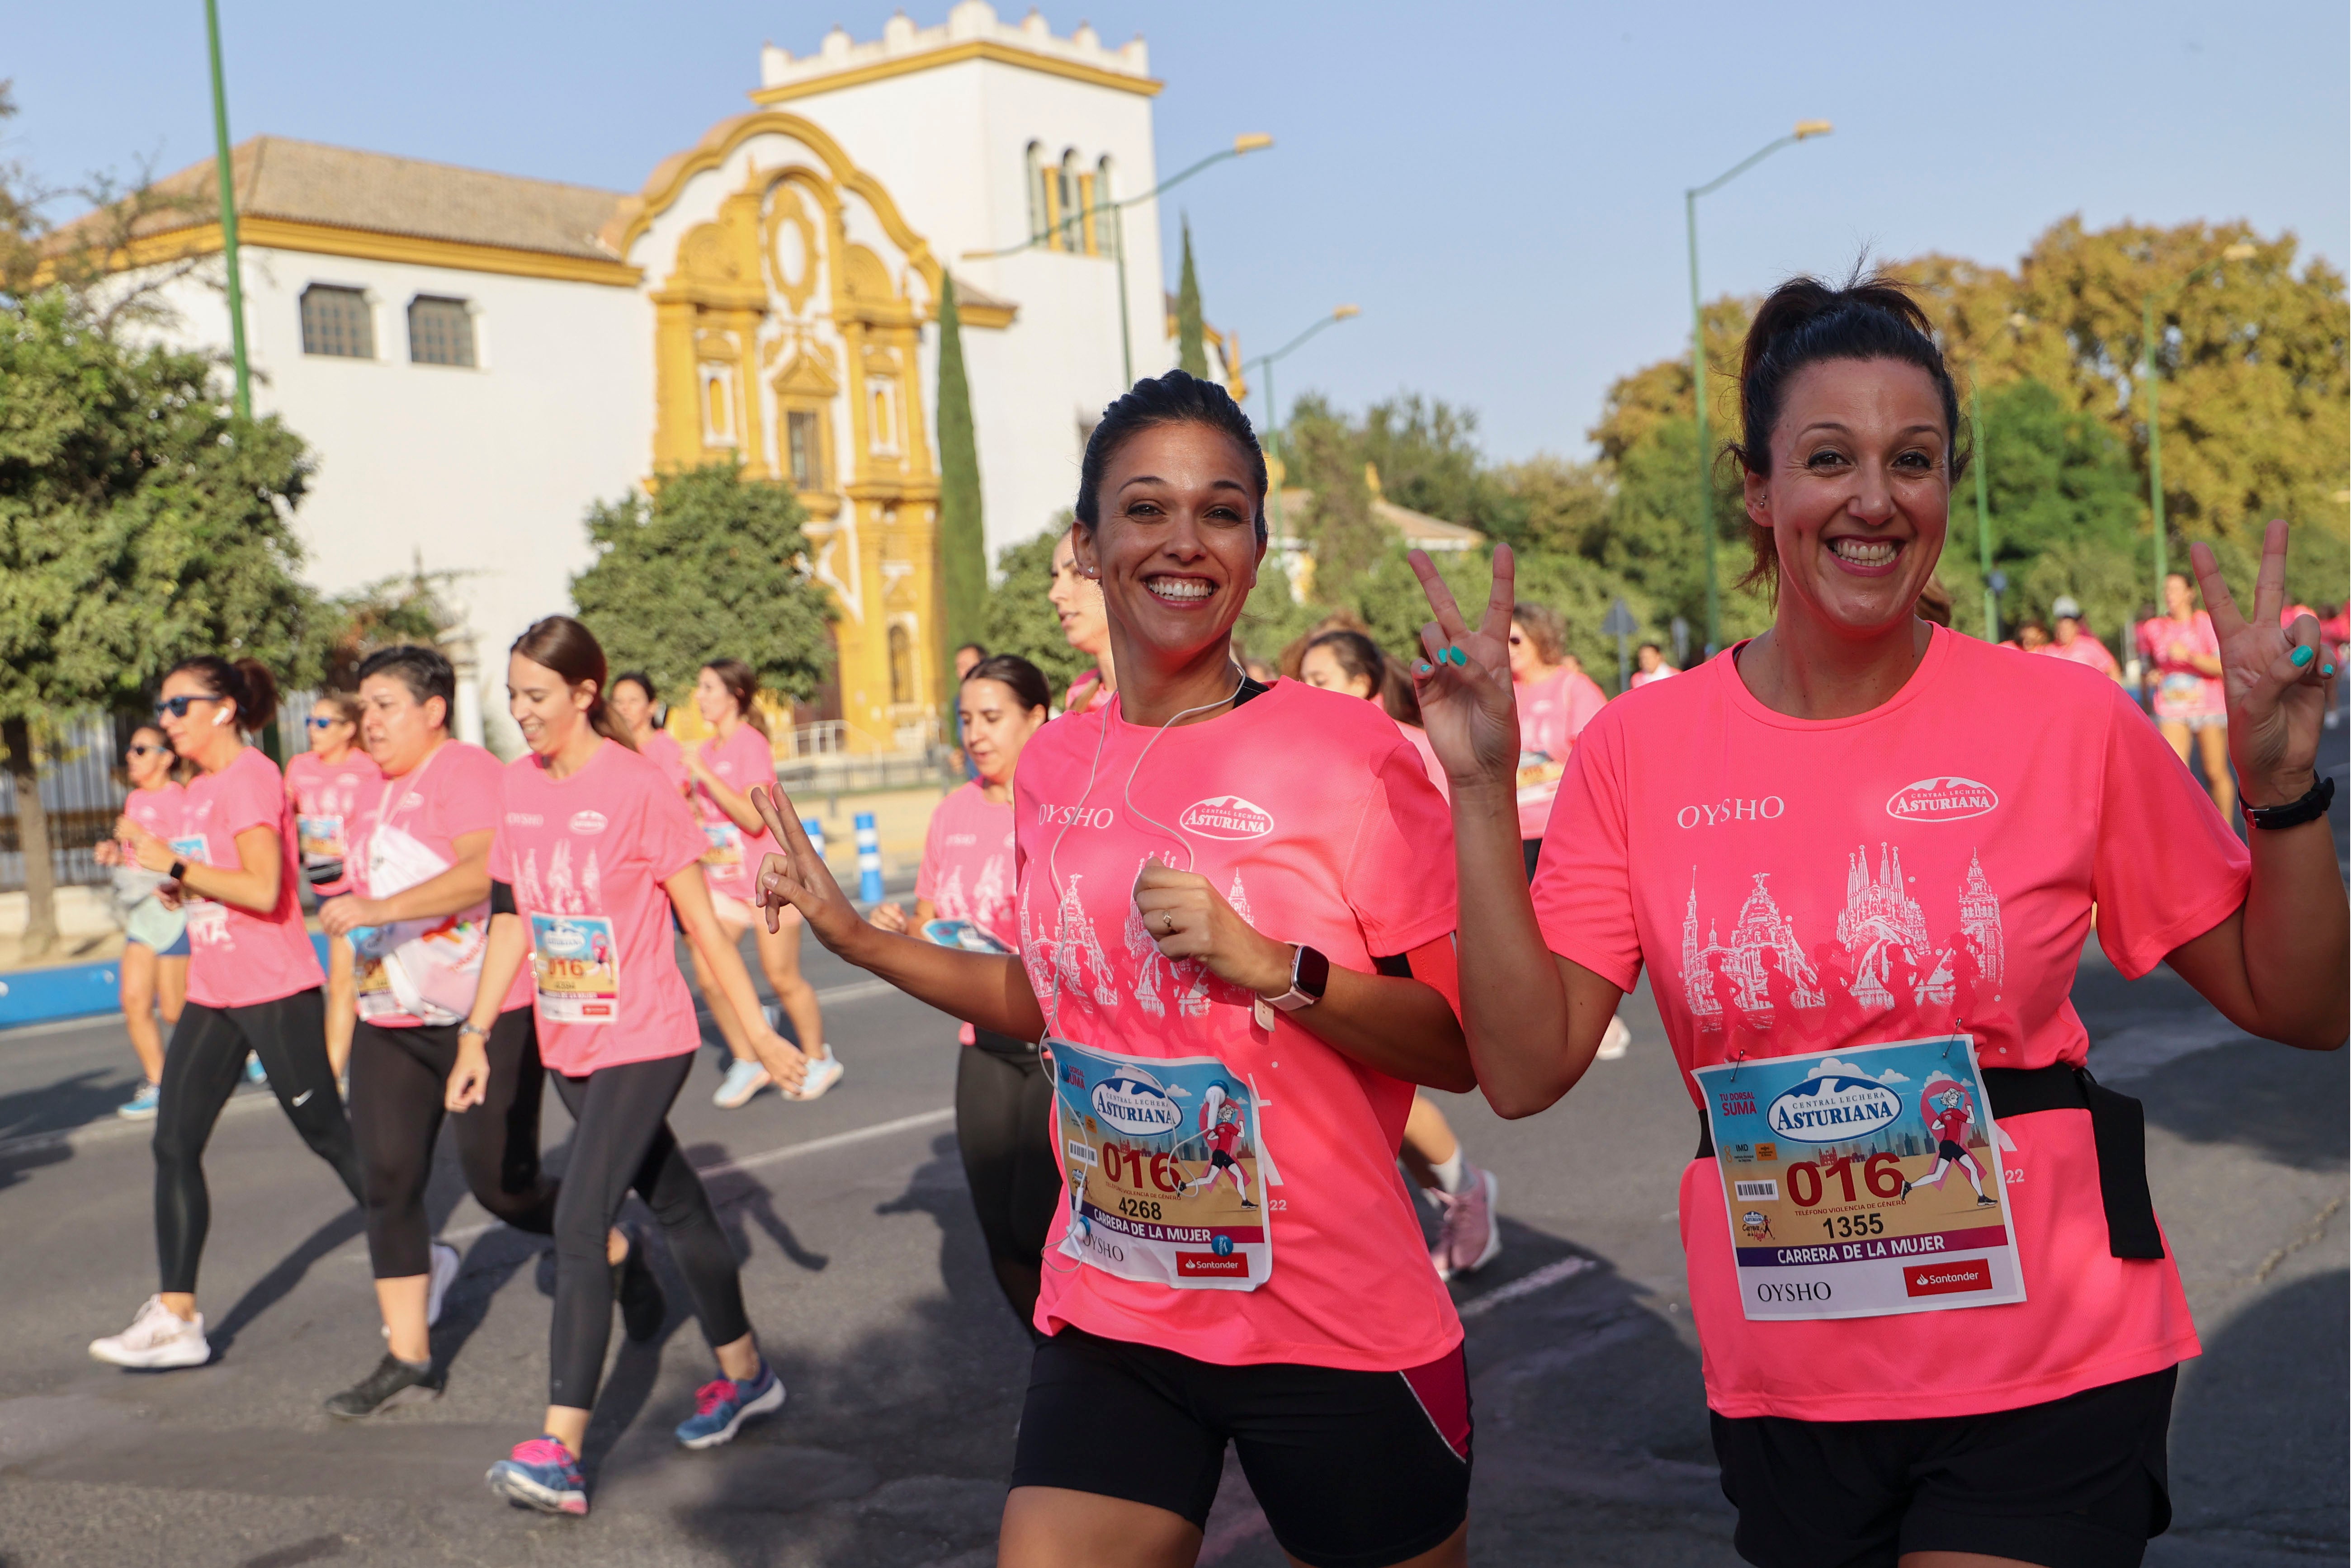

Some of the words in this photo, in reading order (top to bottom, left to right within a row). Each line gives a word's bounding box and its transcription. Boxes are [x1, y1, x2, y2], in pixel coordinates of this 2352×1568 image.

[1677, 796, 1785, 829] OYSHO
[1895, 796, 1991, 814] ASTURIANA
[1039, 804, 1114, 829] OYSHO
[1185, 809, 1265, 832] ASTURIANA
[1067, 1073, 1085, 1090] UMA
[1106, 1092, 1132, 1104] CENTRAL
[1719, 1093, 1728, 1101] TU
[1730, 1091, 1755, 1100] DORSAL
[1792, 1098, 1836, 1109] CENTRAL
[1840, 1091, 1885, 1103] LECHERA
[1097, 1091, 1176, 1124] ASTURIANA
[1722, 1100, 1757, 1116] SUMA
[1777, 1101, 1894, 1130] ASTURIANA
[1736, 1143, 1748, 1152] IMD
[1103, 1142, 1181, 1192] 016
[1786, 1152, 1906, 1207] 016
[1122, 1190, 1149, 1198] VIOLENCIA
[1119, 1197, 1162, 1220] 4268
[1268, 1200, 1287, 1210] 22
[1795, 1208, 1828, 1216] TELÉFONO
[1829, 1205, 1865, 1213] VIOLENCIA
[1877, 1199, 1906, 1208] GÉNERO
[1094, 1208, 1129, 1233] CARRERA
[1131, 1223, 1145, 1237] DE
[1148, 1225, 1163, 1239] LA
[1167, 1228, 1211, 1242] MUJER
[1823, 1213, 1884, 1239] 1355
[1777, 1245, 1839, 1264] CARRERA
[1843, 1242, 1863, 1260] DE
[1866, 1241, 1887, 1257] LA
[1890, 1235, 1945, 1254] MUJER
[1196, 1261, 1238, 1269] Santander
[1930, 1271, 1979, 1285] Santander
[1757, 1281, 1831, 1302] OYSHO
